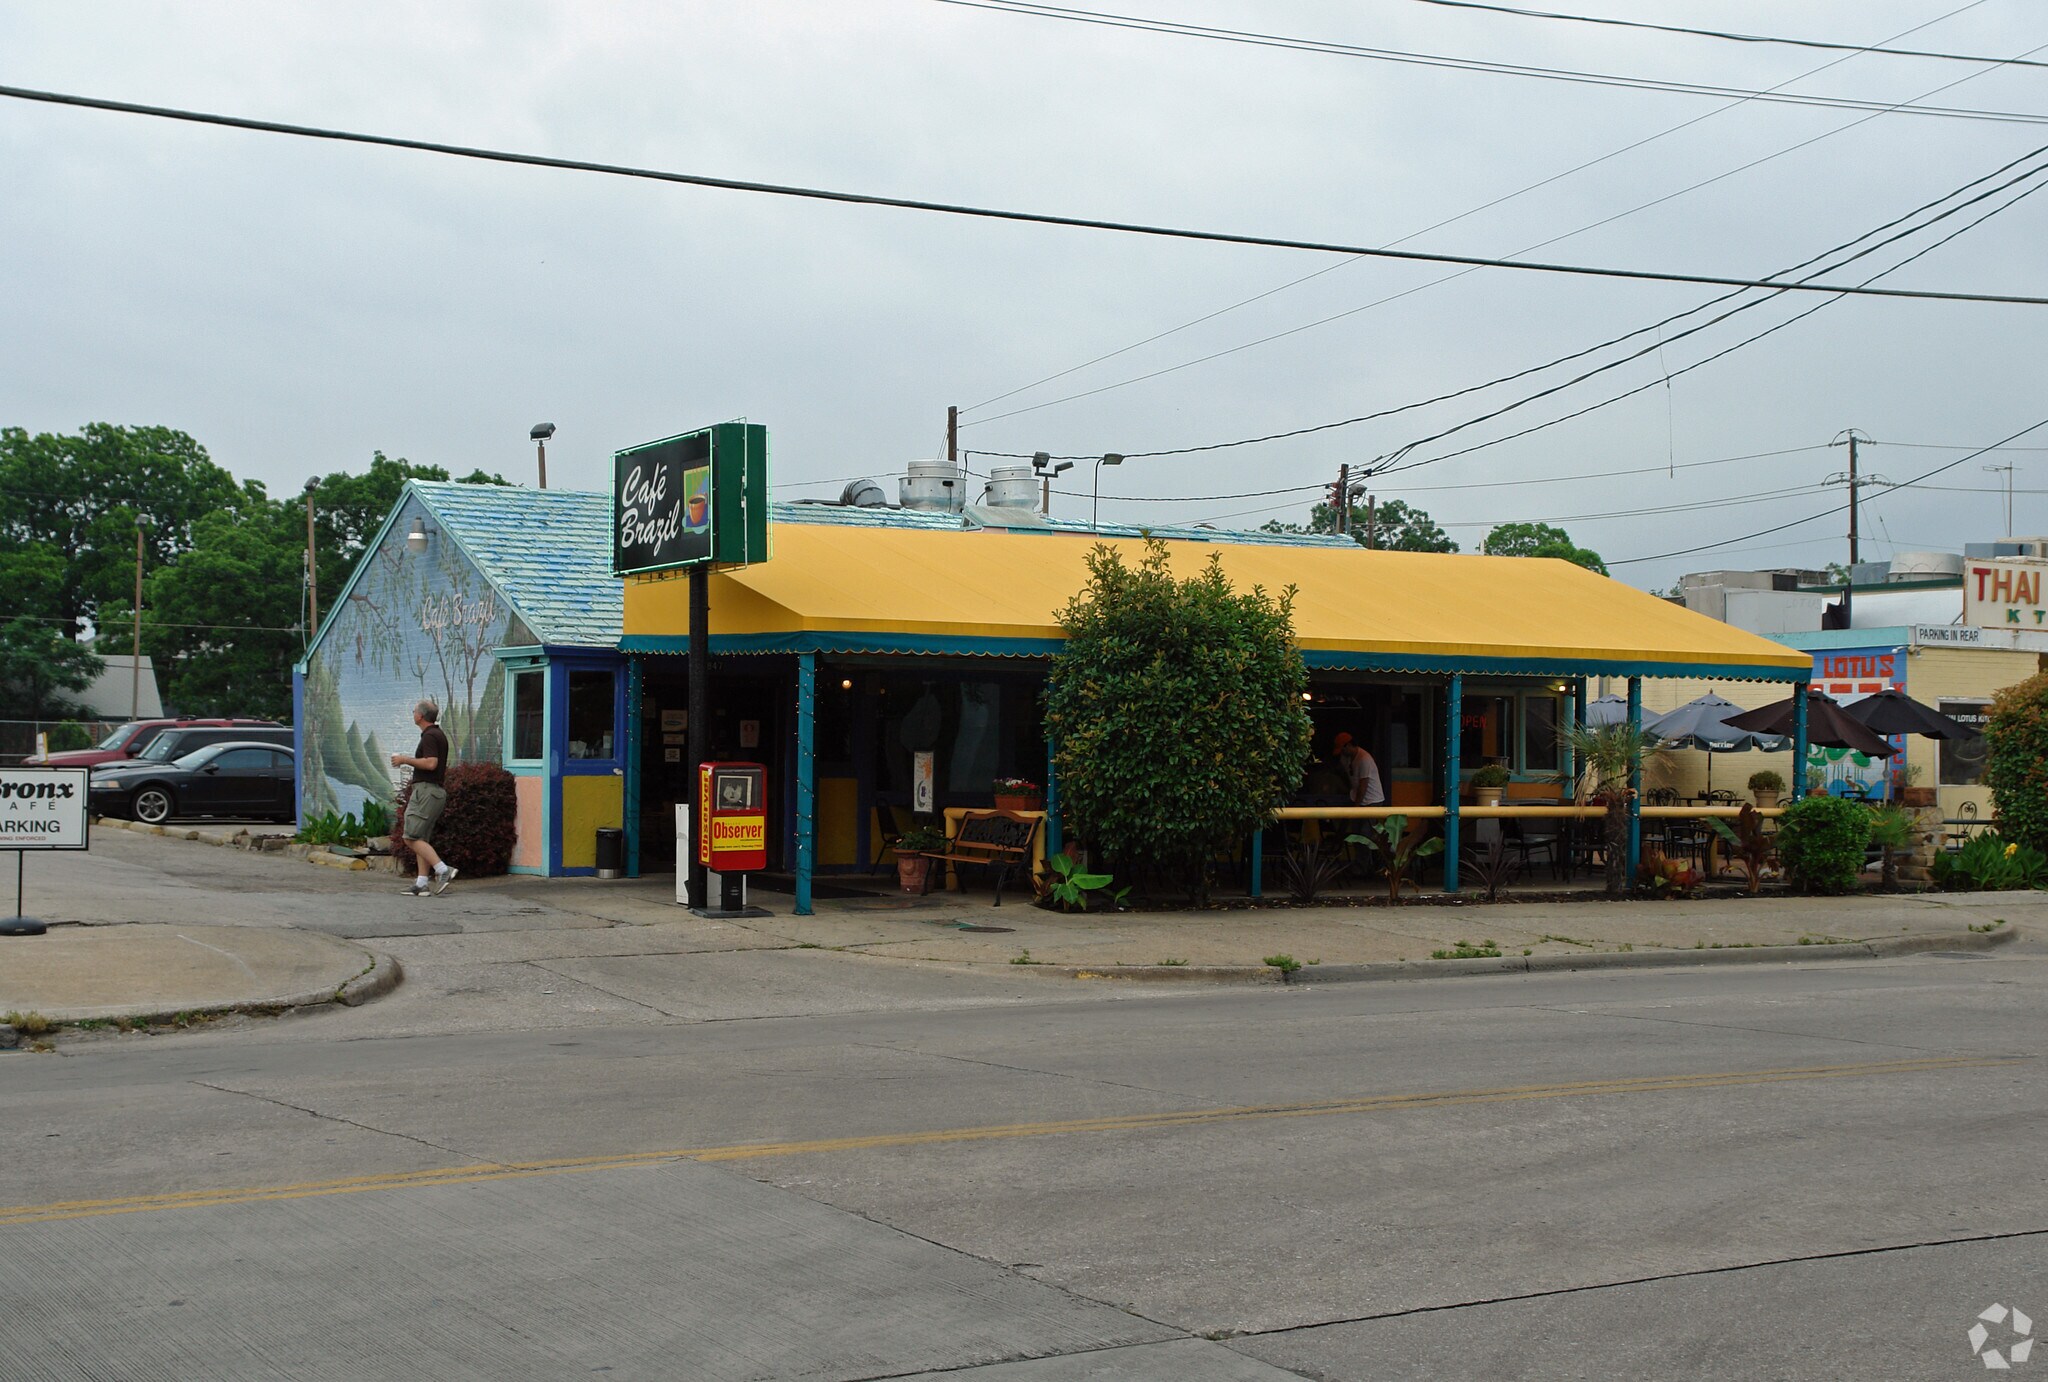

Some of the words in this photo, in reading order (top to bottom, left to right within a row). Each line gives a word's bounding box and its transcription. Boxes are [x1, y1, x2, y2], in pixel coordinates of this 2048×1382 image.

[622, 463, 667, 516] Café
[621, 500, 680, 557] Brazil
[1973, 567, 2040, 605] THAI
[1920, 628, 1949, 641] PARKING
[1950, 630, 1958, 641] IN
[1960, 630, 1979, 642] REAR
[1823, 655, 1895, 678] LOTUS
[1957, 714, 1977, 723] LOTUS
[0, 778, 74, 799] ronx
[713, 821, 763, 839] Observer
